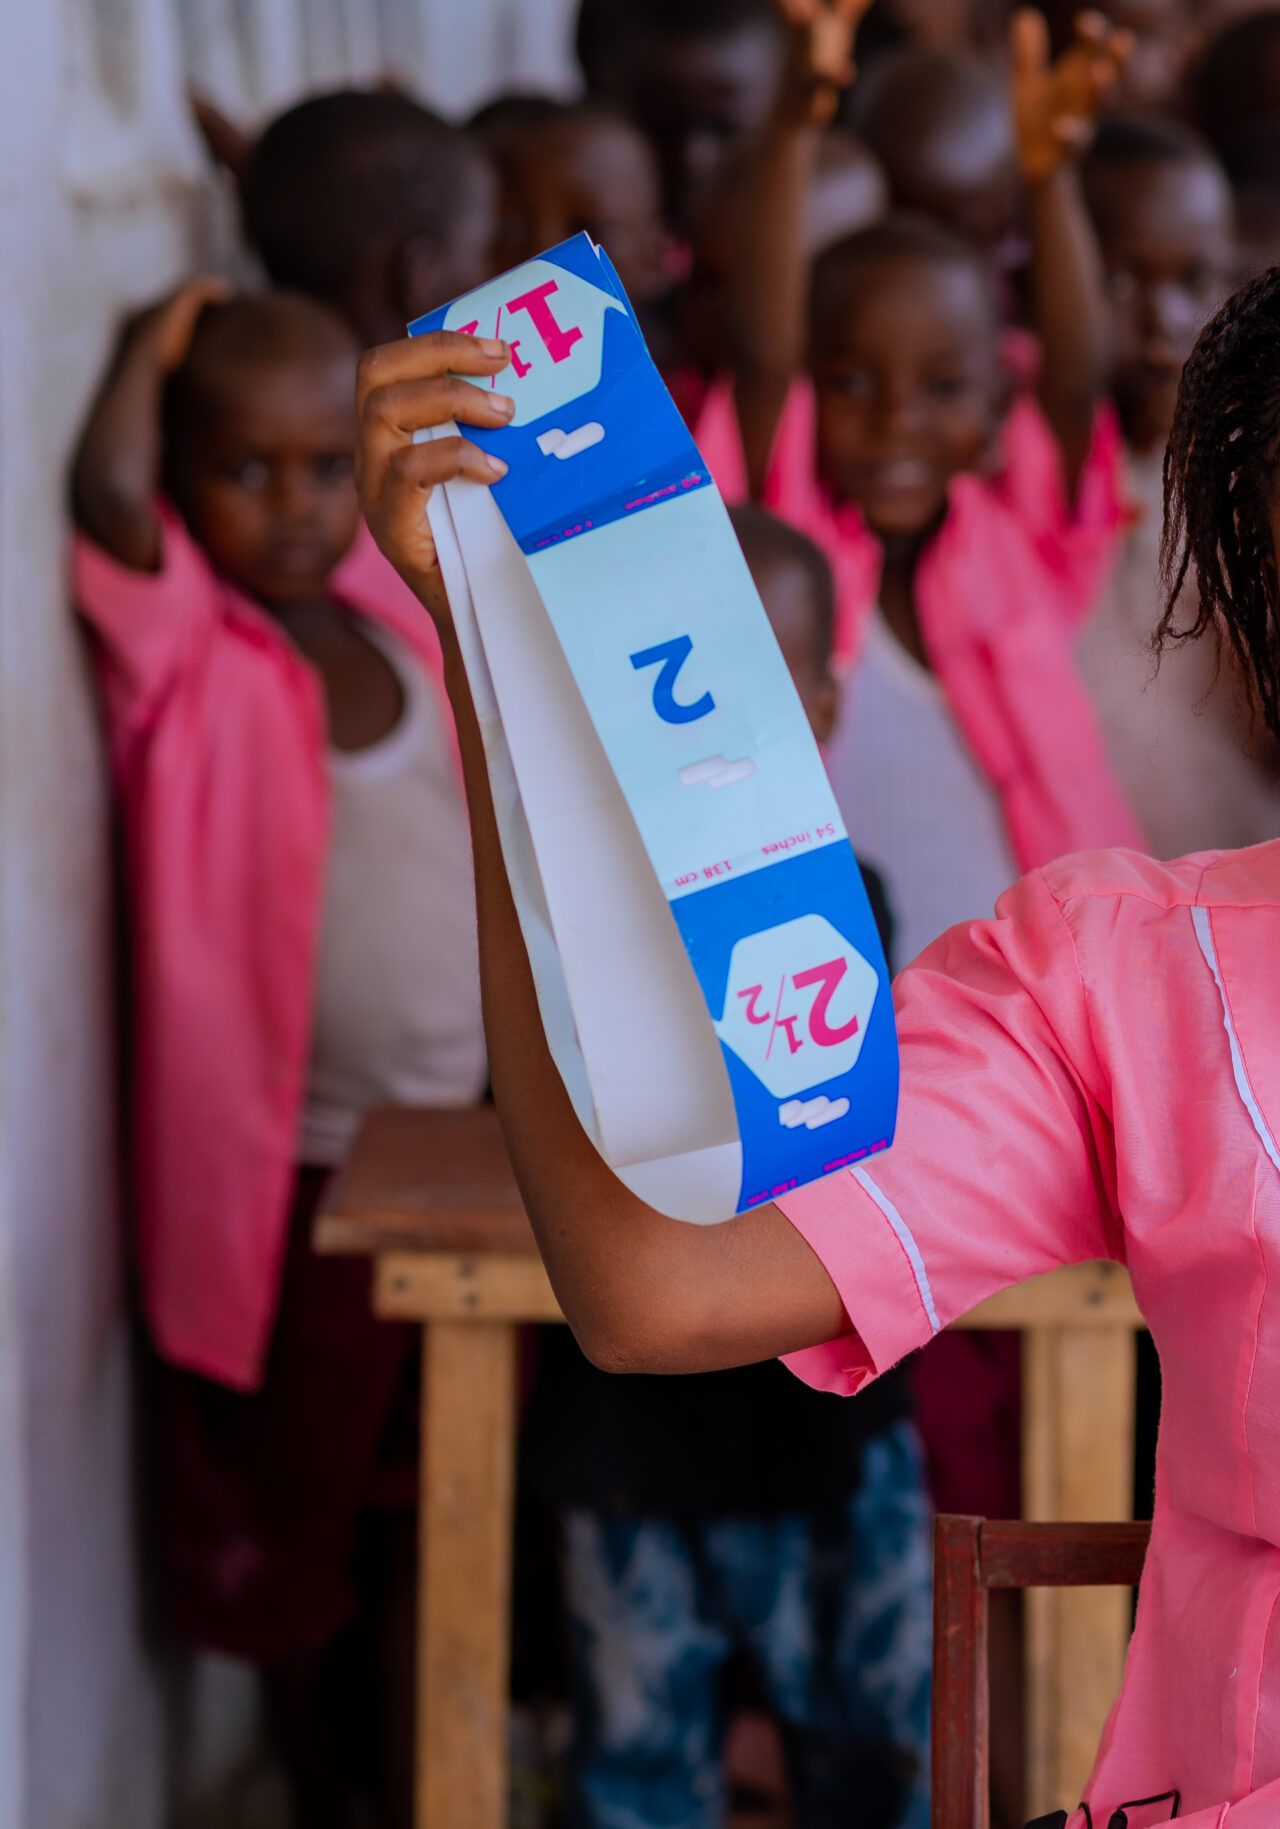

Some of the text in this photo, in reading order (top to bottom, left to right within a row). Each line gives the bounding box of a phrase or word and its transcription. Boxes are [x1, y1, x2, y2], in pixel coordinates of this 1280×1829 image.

[629, 634, 715, 724] 2
[761, 822, 835, 855] 54 inches
[674, 860, 732, 886] 138 cm
